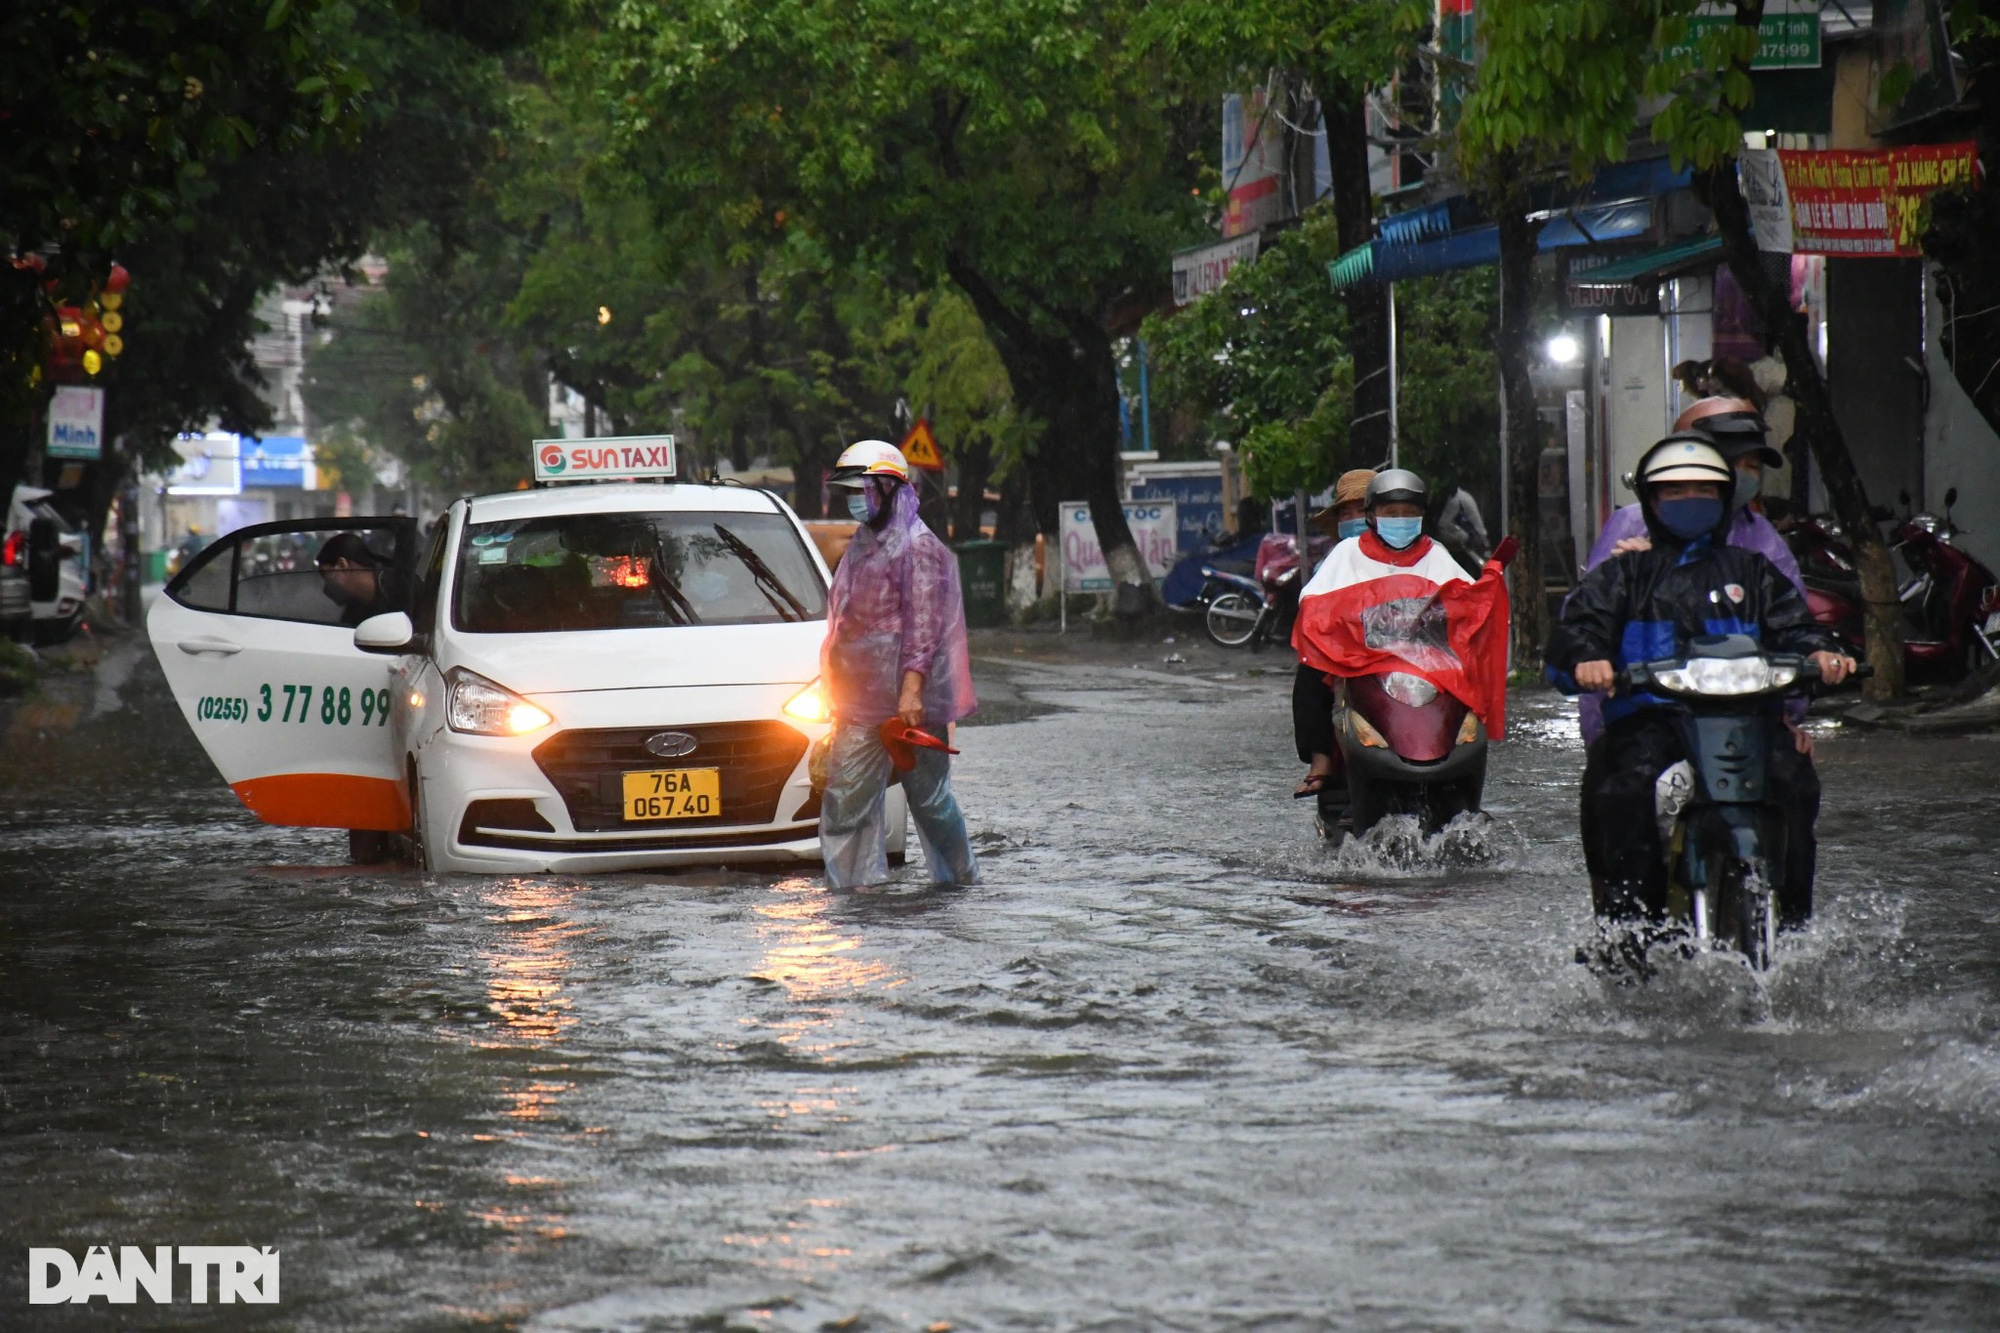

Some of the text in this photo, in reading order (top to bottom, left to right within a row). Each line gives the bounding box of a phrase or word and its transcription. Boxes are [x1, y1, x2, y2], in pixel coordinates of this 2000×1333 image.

[53, 422, 96, 444] Minh
[571, 446, 668, 469] SUN TAXI
[197, 696, 248, 724] (0255)
[650, 773, 691, 794] 76A
[634, 794, 710, 818] 067.40
